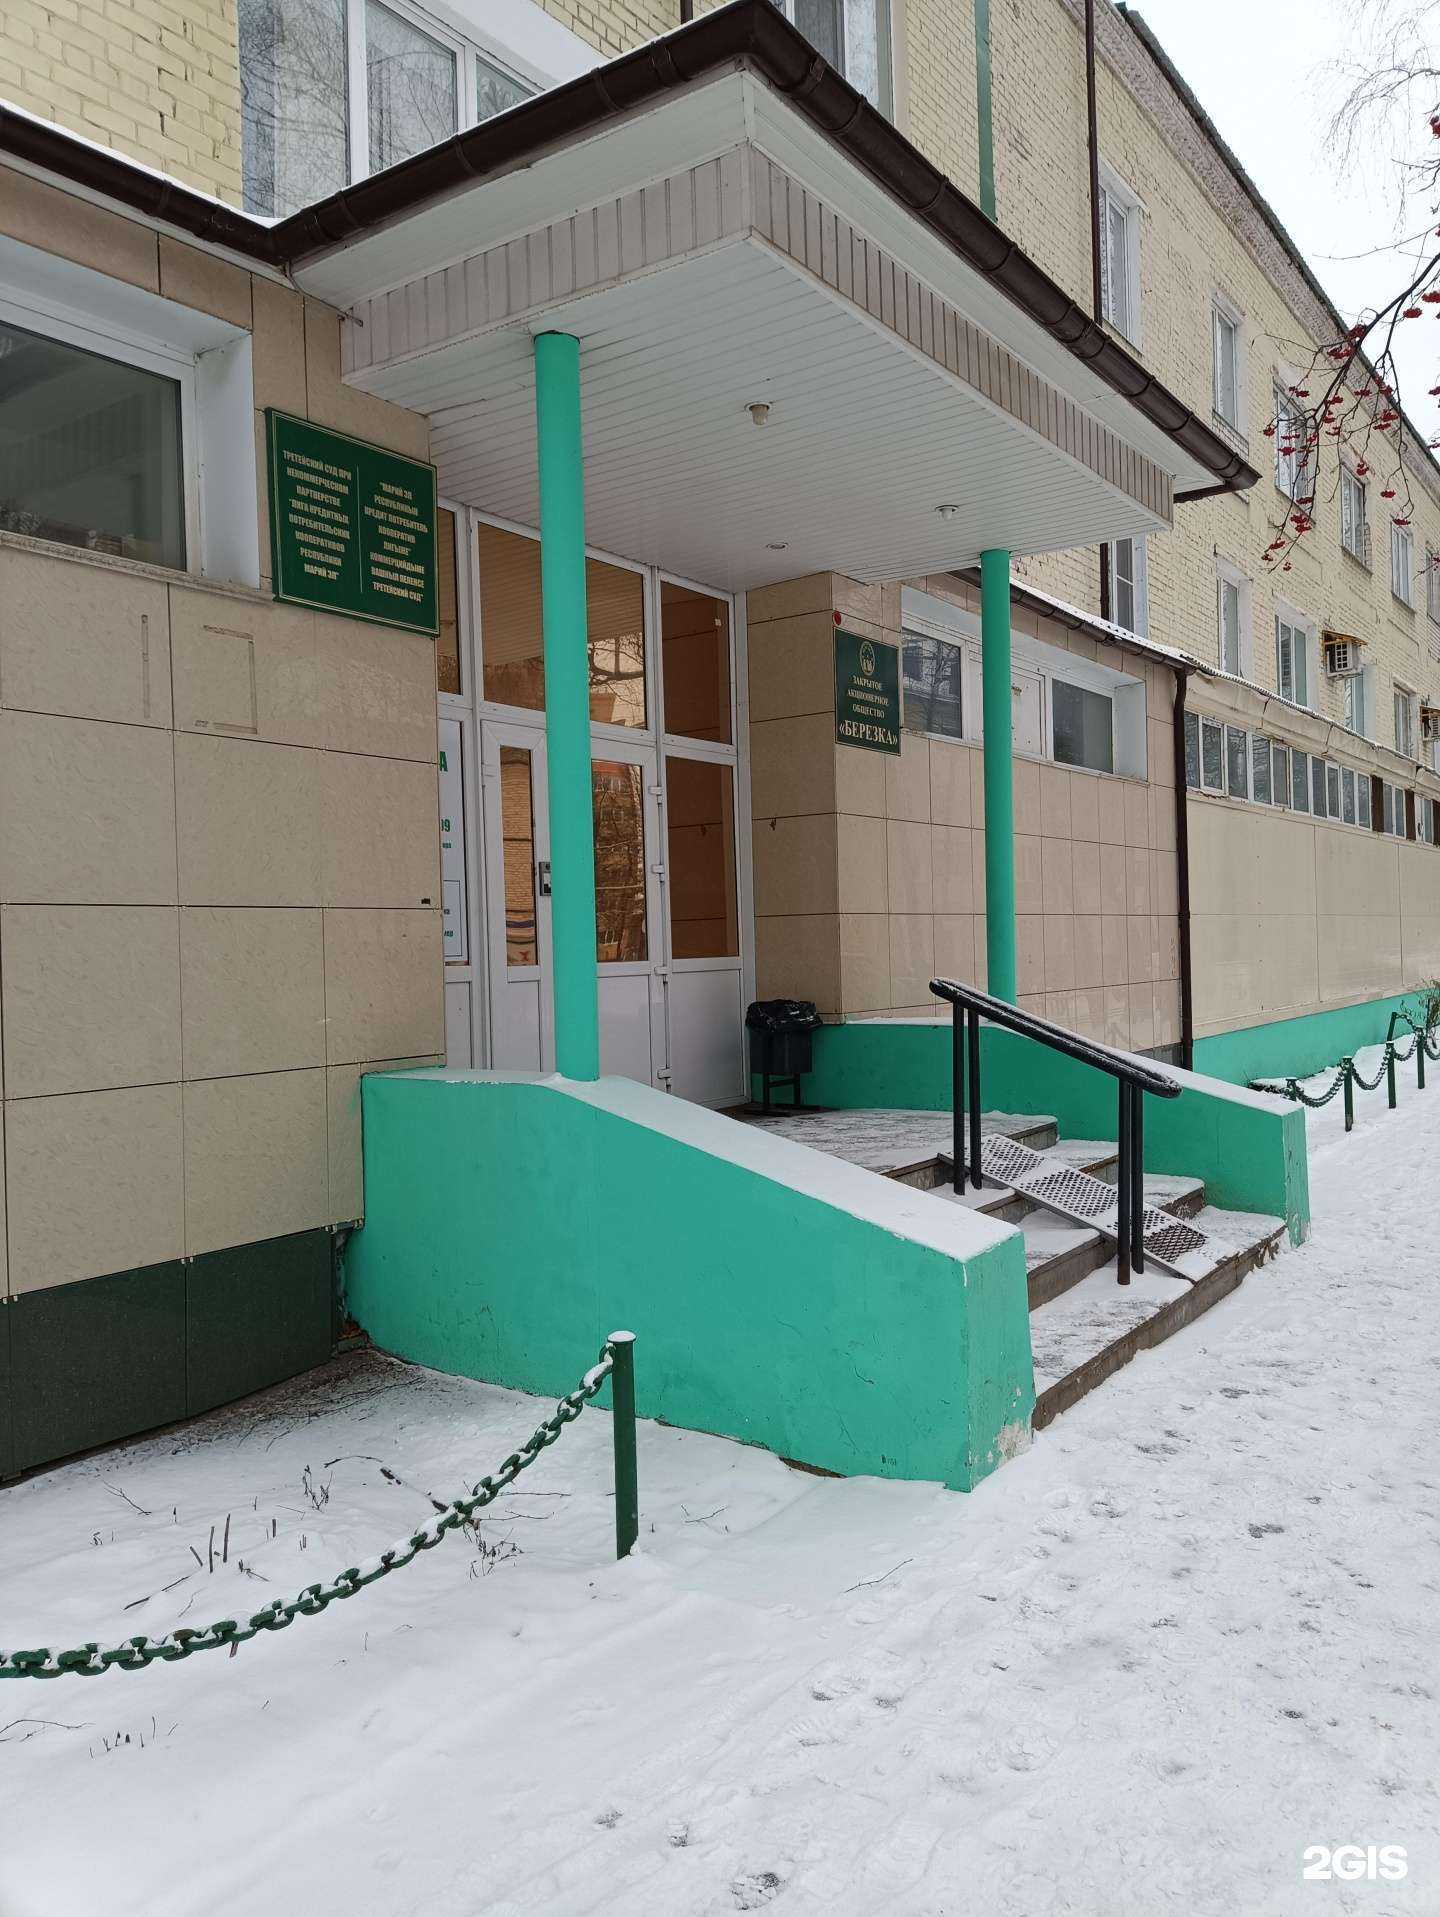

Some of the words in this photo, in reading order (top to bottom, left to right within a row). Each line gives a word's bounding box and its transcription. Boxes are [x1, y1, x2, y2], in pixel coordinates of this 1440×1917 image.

[853, 675, 882, 690] ЗАКРЫТОЕ
[853, 704, 884, 718] ОБЩЕСТВО
[840, 720, 897, 745] «БЕРЕЗКА»
